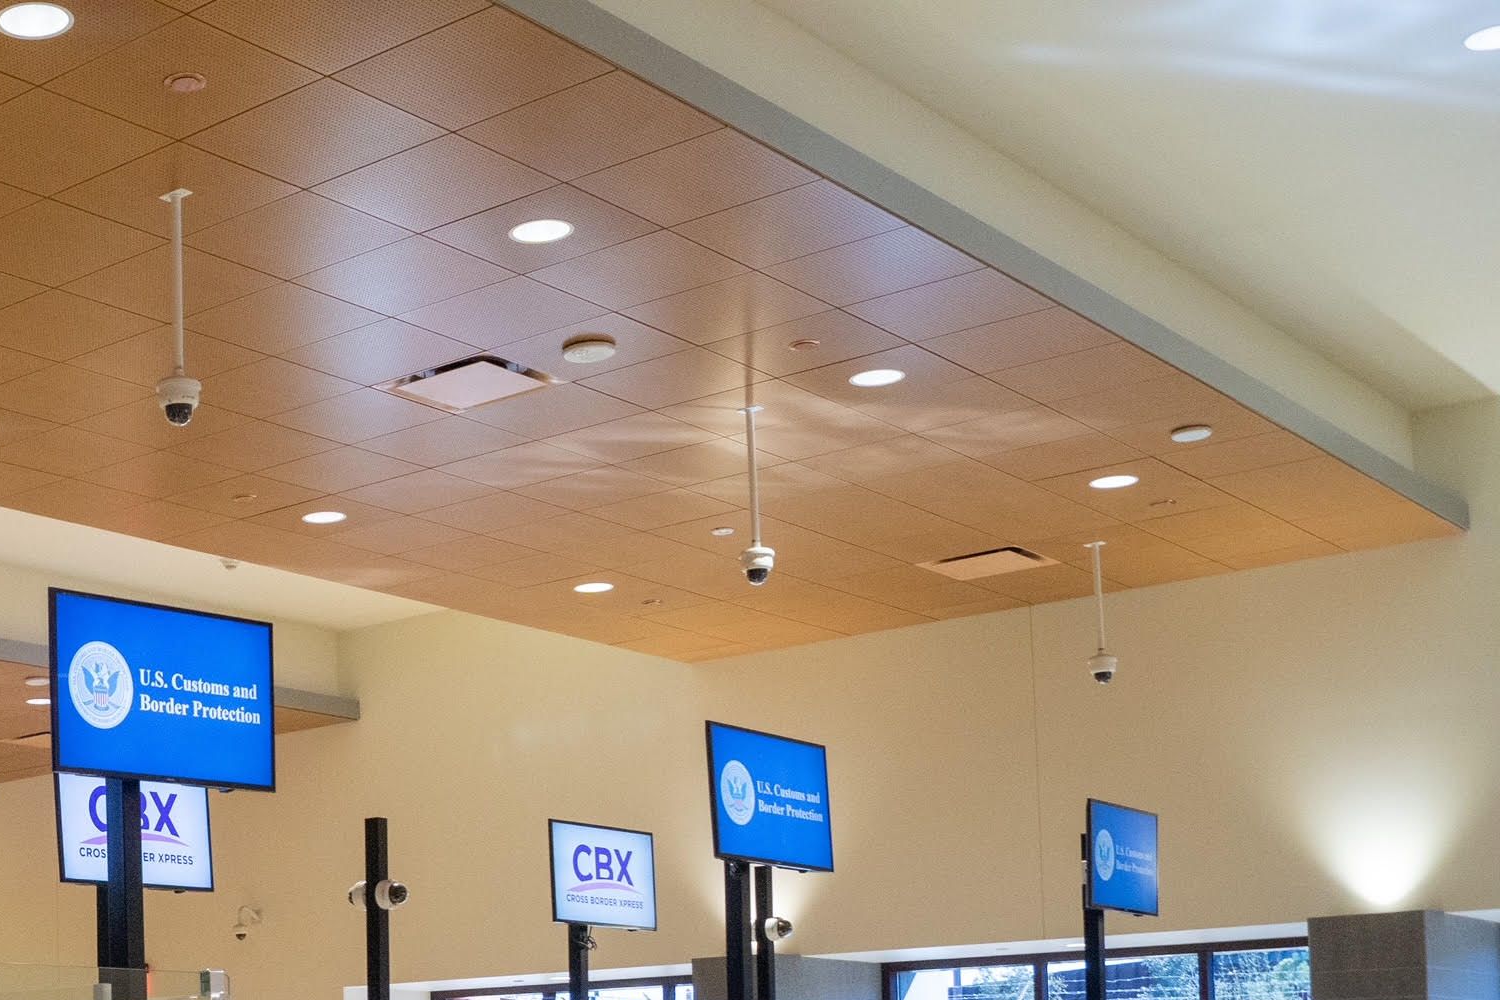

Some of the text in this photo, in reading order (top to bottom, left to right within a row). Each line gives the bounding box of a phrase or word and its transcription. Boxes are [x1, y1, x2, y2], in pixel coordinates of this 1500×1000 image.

[139, 668, 257, 700] U.S. Customs and
[139, 694, 261, 725] Border Protection
[756, 780, 820, 804] U.S. Customs and
[758, 799, 823, 822] Border Protection
[79, 847, 108, 858] CROS
[158, 853, 194, 865] XPRESS
[572, 844, 634, 887] CBX
[566, 894, 589, 904] CROSS
[590, 896, 618, 907] BORDER
